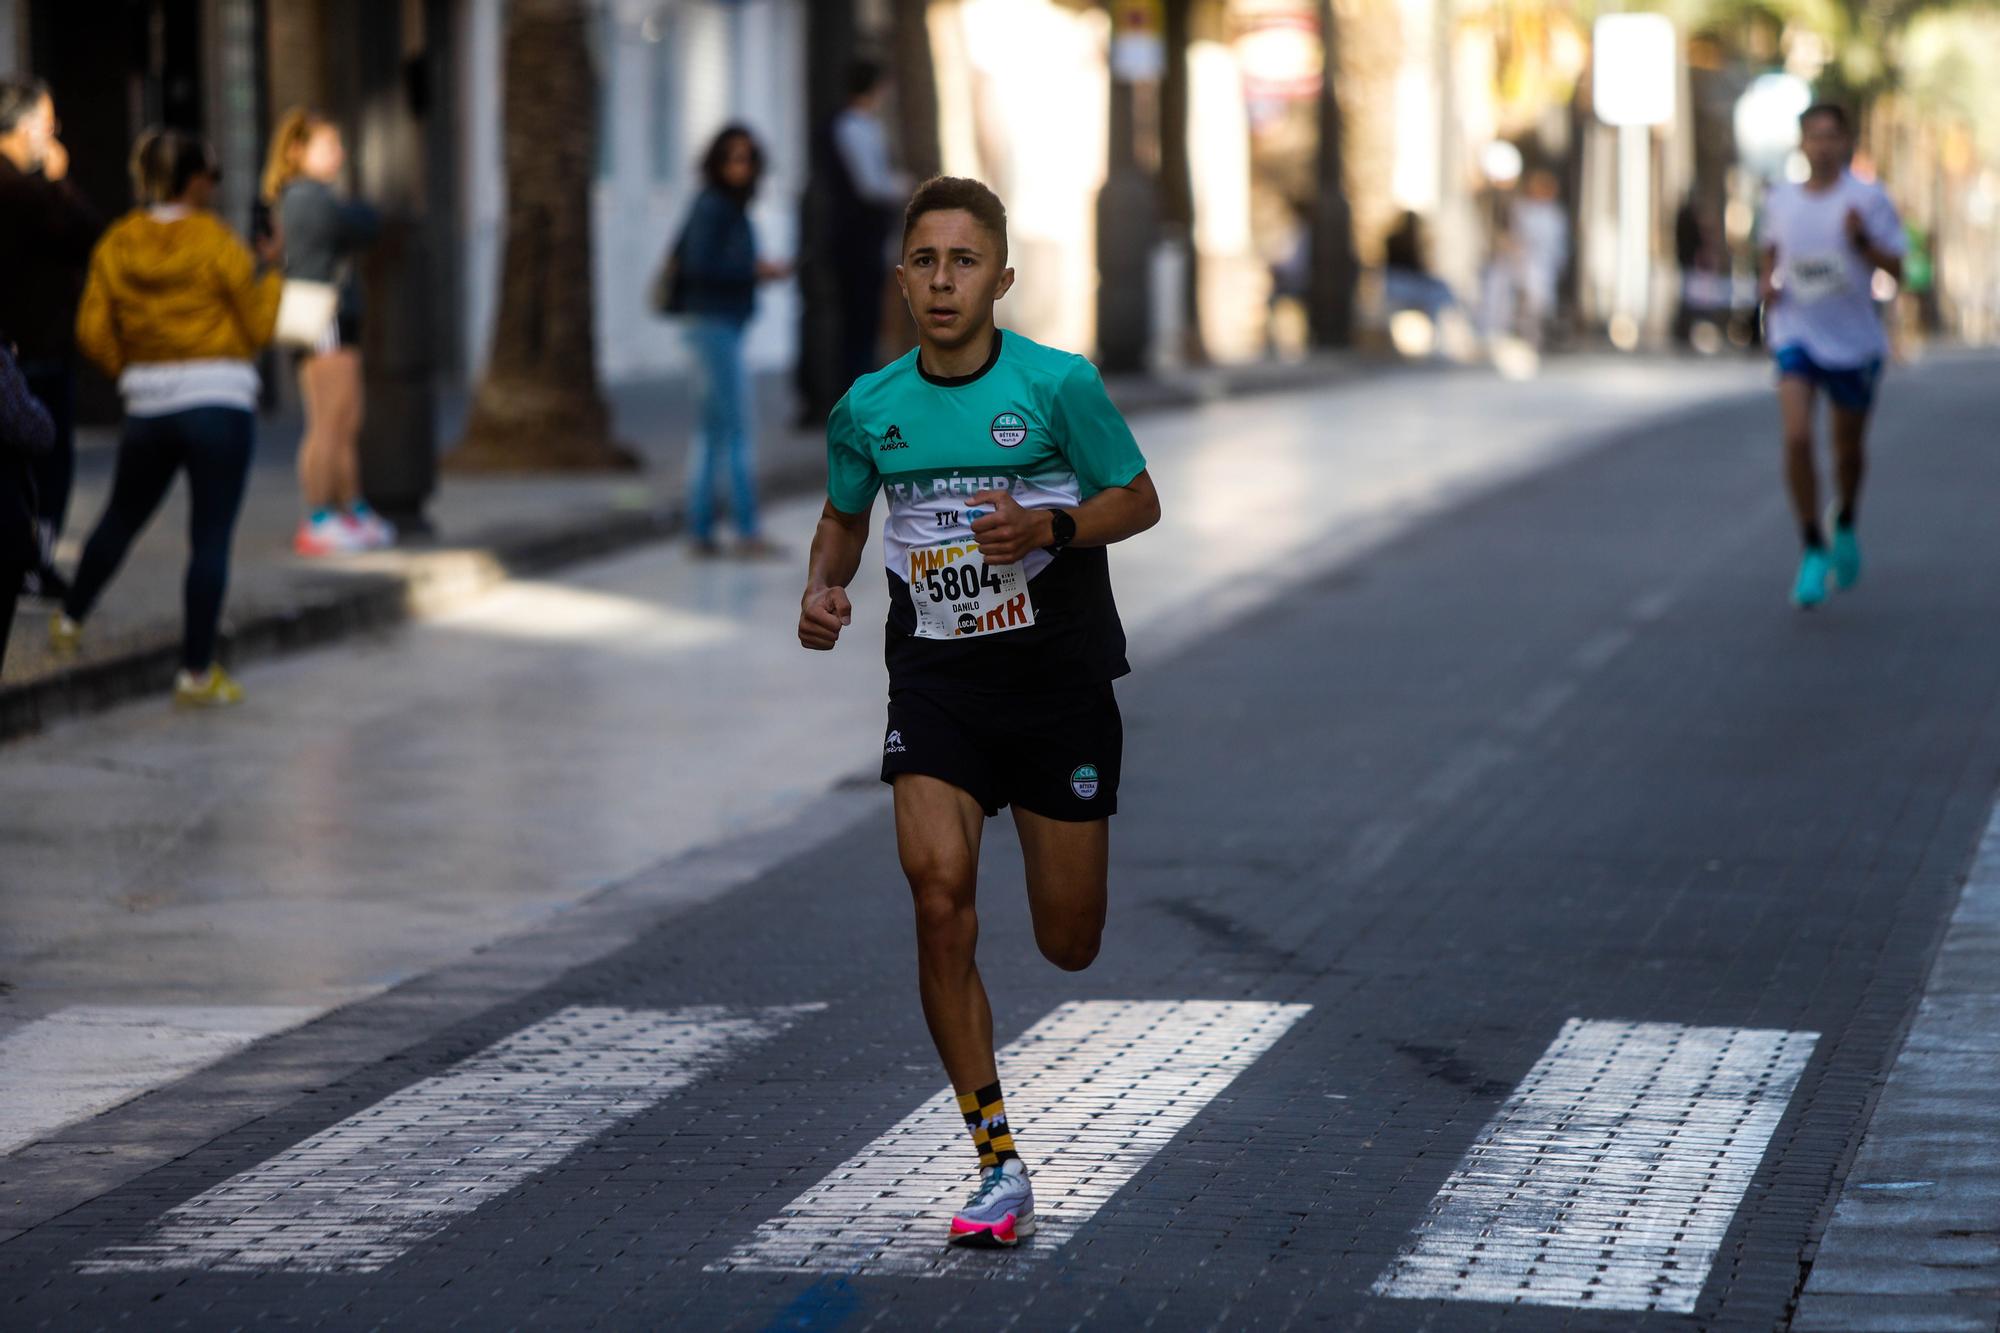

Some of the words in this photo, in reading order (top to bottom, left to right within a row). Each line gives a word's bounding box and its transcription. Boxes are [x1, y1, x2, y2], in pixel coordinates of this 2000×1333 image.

[999, 416, 1018, 425] CEA
[935, 510, 959, 526] ITV
[925, 562, 1001, 603] 5804
[952, 601, 979, 613] DANILO
[958, 619, 977, 629] LOCAL
